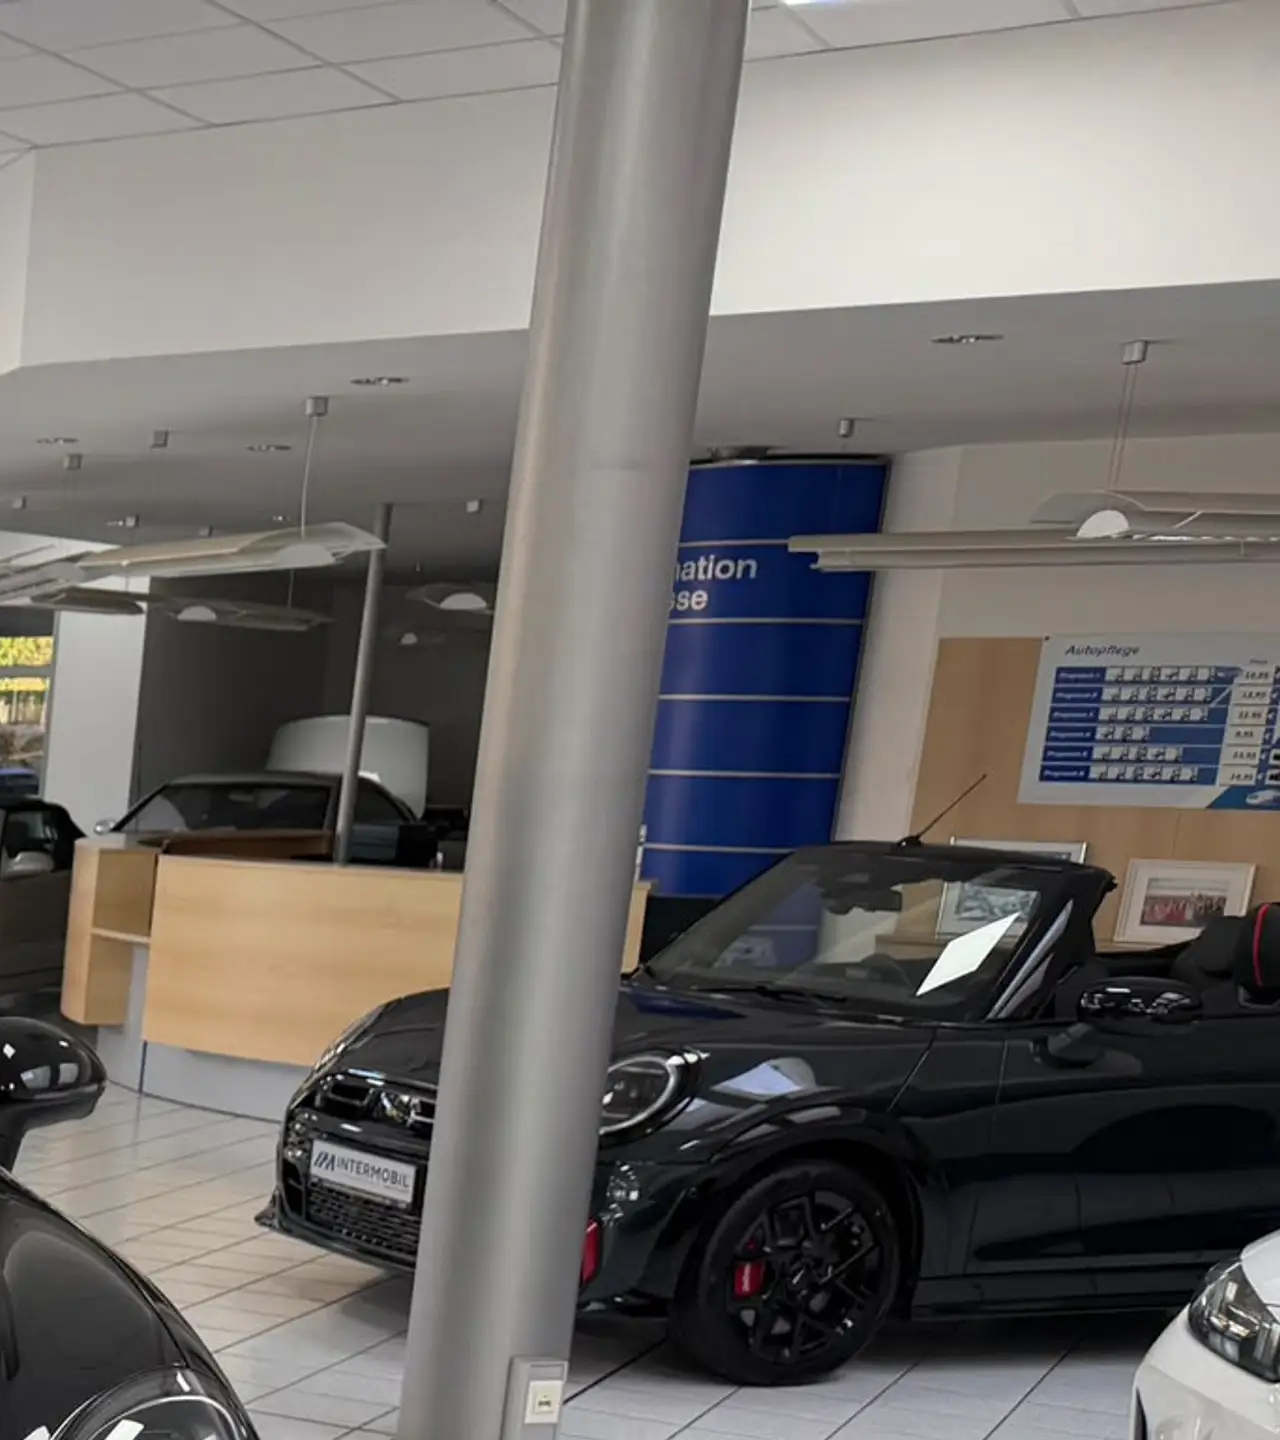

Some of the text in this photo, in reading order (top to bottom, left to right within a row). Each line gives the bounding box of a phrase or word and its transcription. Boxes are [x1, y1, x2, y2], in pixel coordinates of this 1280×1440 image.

[675, 554, 757, 580] ation
[1065, 644, 1140, 657] Autopflege
[336, 1157, 411, 1189] INTERMOBIL
